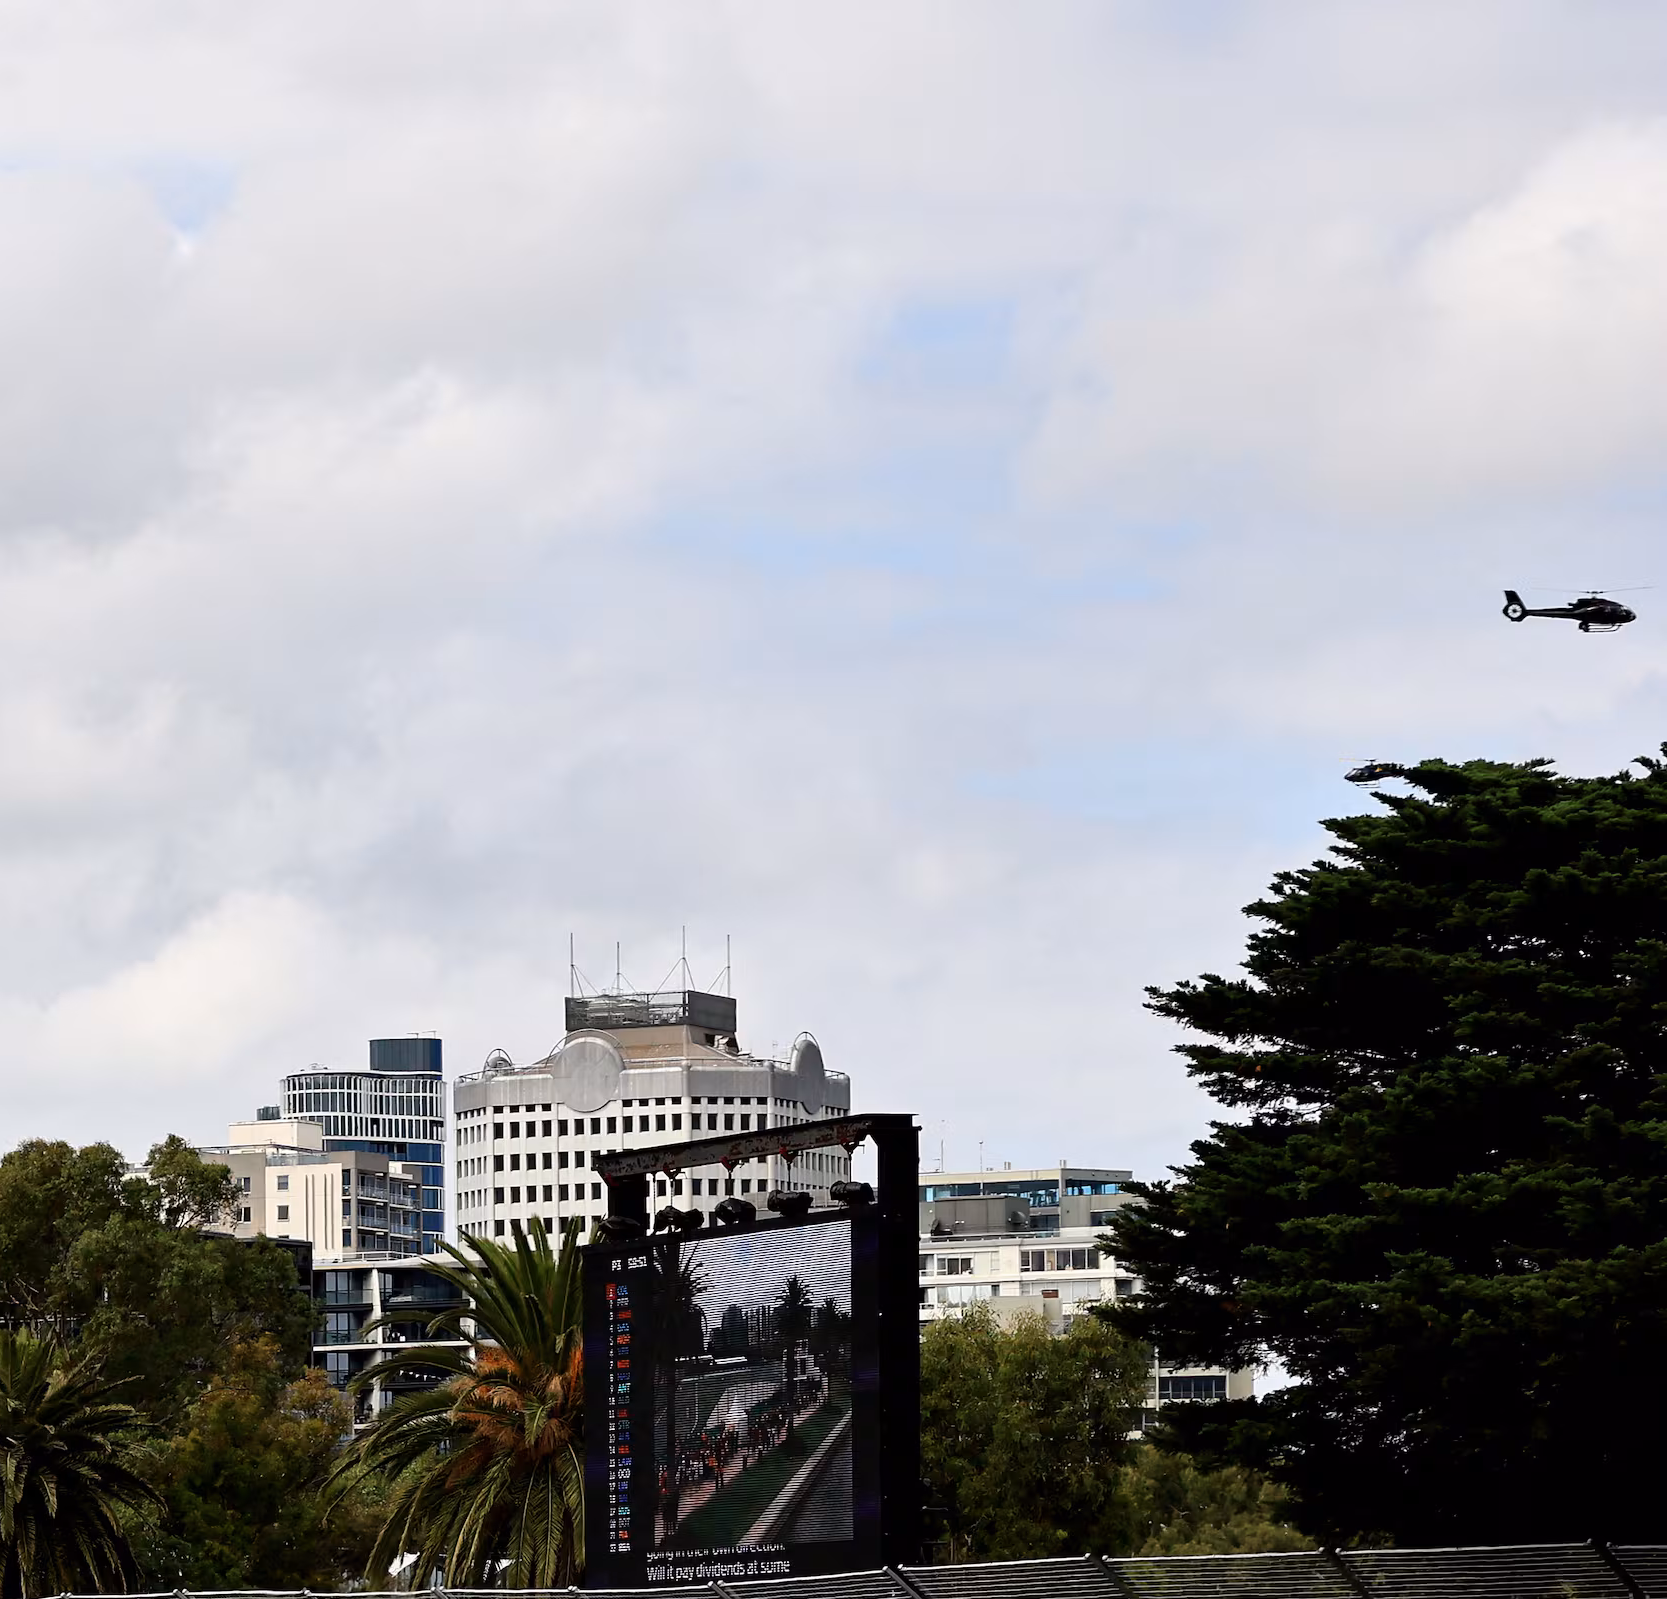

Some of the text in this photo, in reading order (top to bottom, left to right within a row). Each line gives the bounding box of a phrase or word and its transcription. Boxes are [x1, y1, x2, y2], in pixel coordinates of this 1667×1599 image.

[675, 1565, 695, 1581] pay
[695, 1561, 745, 1577] dividends
[746, 1560, 759, 1575] at
[760, 1561, 791, 1574] some
